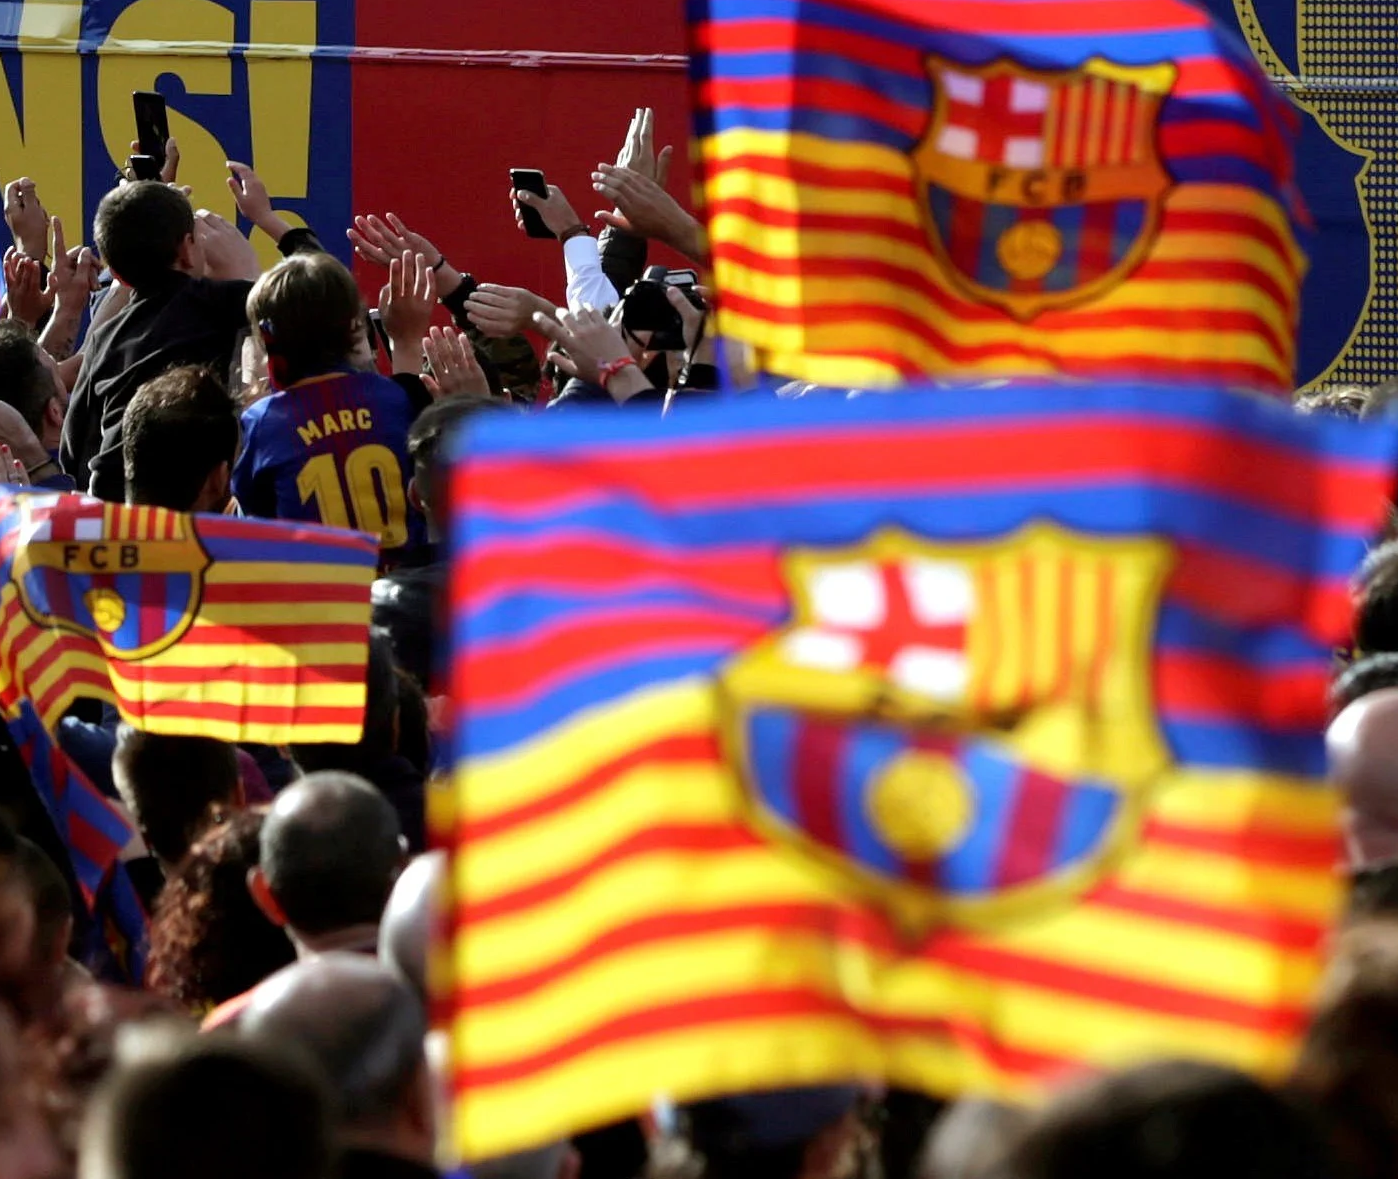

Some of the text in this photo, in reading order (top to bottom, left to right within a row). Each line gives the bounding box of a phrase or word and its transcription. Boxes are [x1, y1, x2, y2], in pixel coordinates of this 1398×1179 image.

[296, 408, 373, 446] MARC
[296, 443, 408, 549] 10
[64, 544, 140, 569] FCB
